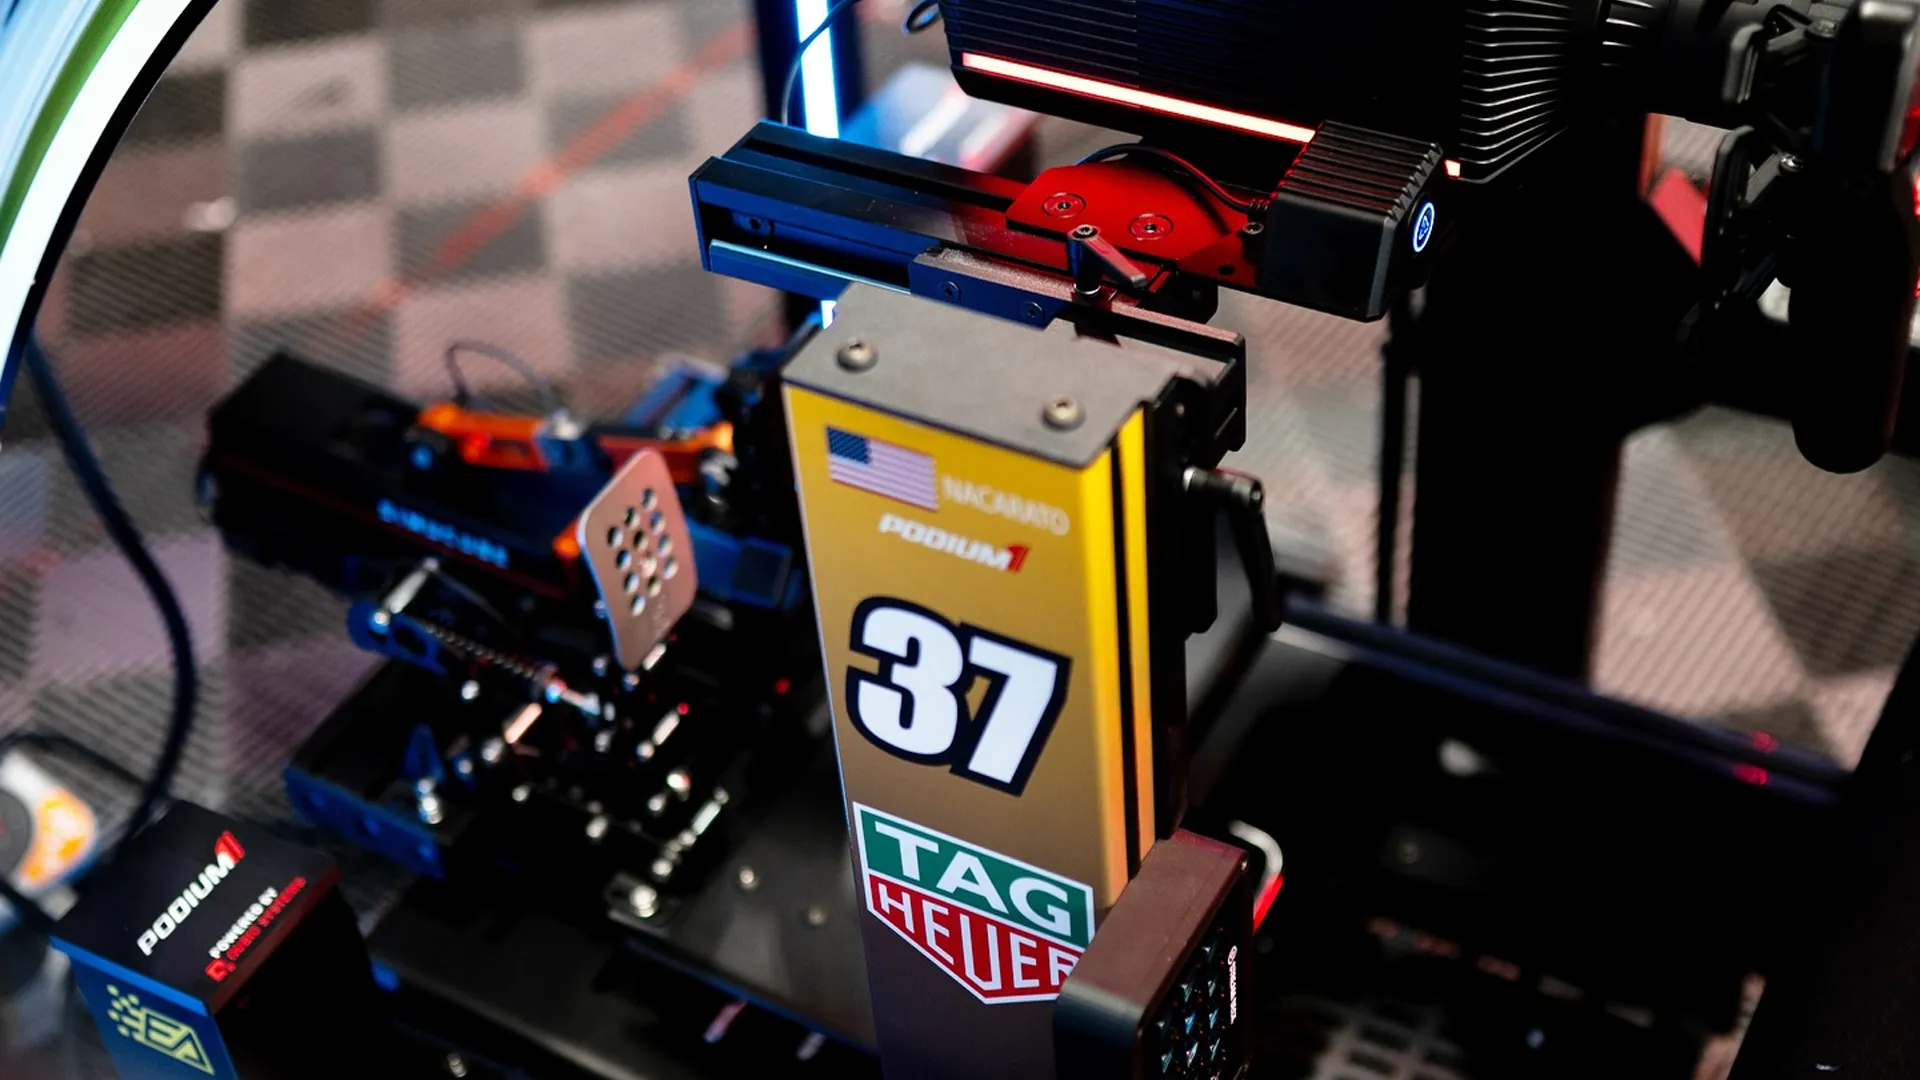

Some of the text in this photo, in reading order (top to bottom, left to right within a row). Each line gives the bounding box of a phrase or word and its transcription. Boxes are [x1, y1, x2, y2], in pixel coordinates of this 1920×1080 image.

[849, 598, 1068, 793] 37
[208, 886, 279, 959] POWERED BY
[874, 820, 1072, 937] TAG
[878, 882, 1080, 991] HEUER
